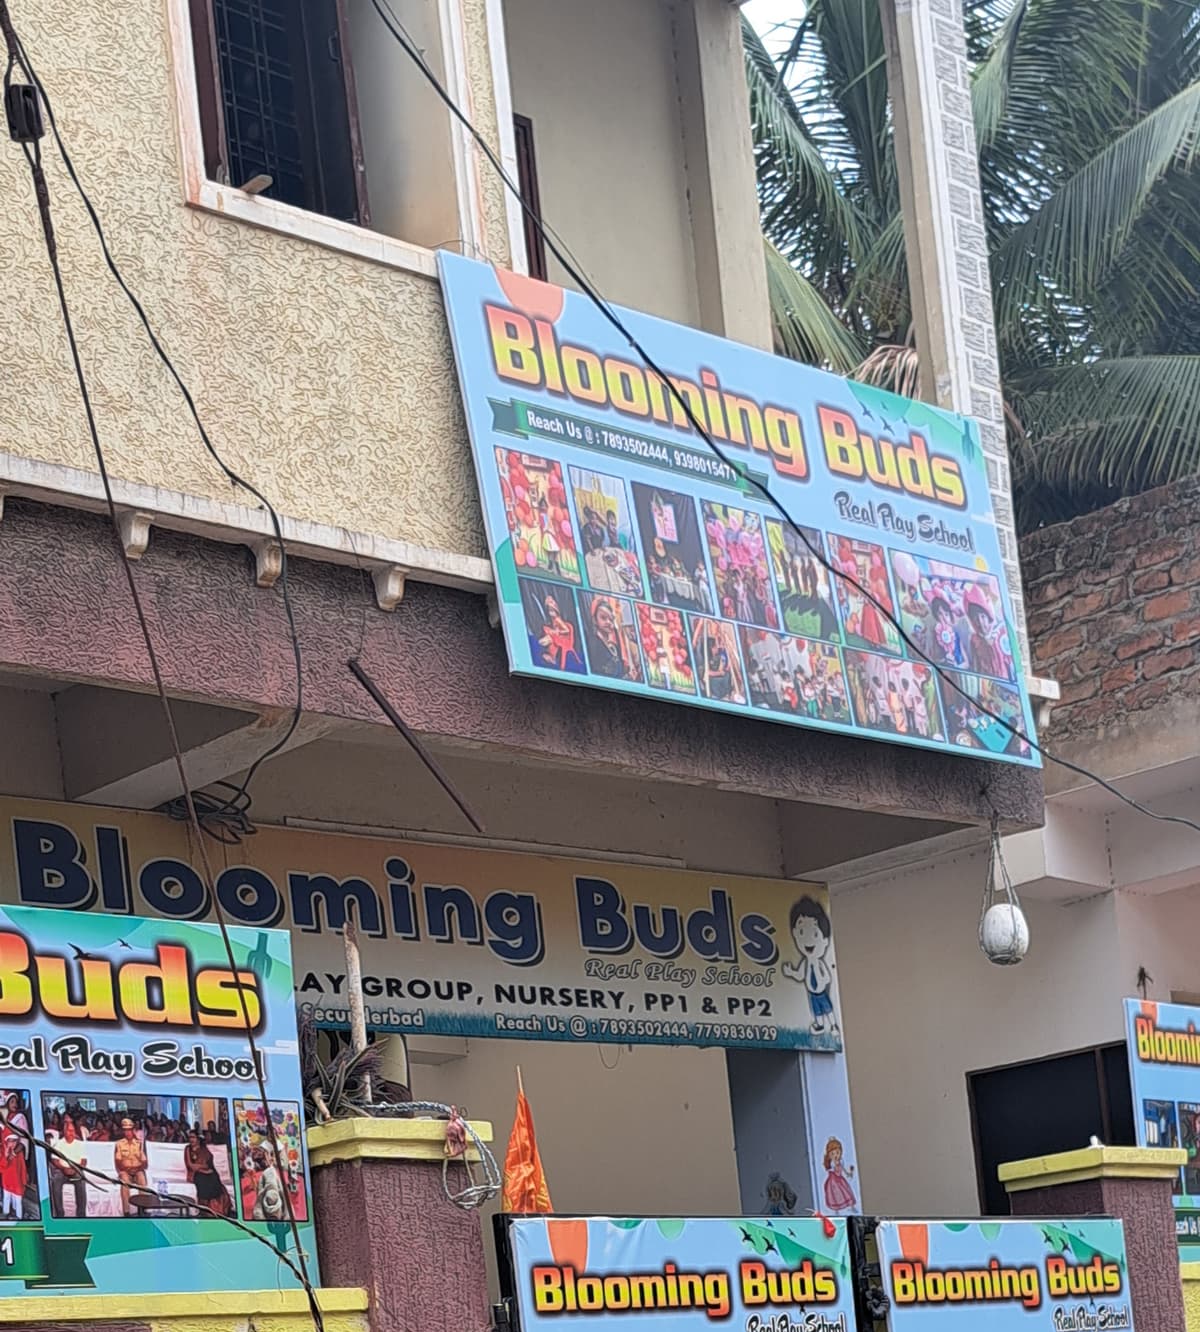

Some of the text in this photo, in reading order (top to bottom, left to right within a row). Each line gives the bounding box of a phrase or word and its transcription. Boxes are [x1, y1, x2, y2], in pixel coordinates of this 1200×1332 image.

[485, 302, 967, 507] Blooming Buds
[527, 410, 564, 435] Reach
[567, 421, 582, 439] Us
[602, 430, 673, 467] 7893502444,
[674, 450, 737, 482] 9398015471
[834, 491, 975, 552] Real Play School
[11, 816, 778, 966] Blooming Buds
[294, 972, 772, 1017] AY GROUP, NURSERY, PP1 & PP2
[585, 958, 776, 988] Real Play School
[495, 1014, 541, 1032] Reach
[546, 1016, 566, 1033] Us
[570, 1016, 588, 1037] @
[52, 1035, 135, 1079] Play
[142, 1041, 267, 1081] School
[532, 1260, 836, 1318] Blooming Buds
[891, 1256, 1122, 1308] Blooming Buds
[1053, 1305, 1077, 1332] Real
[1098, 1304, 1130, 1329] School
